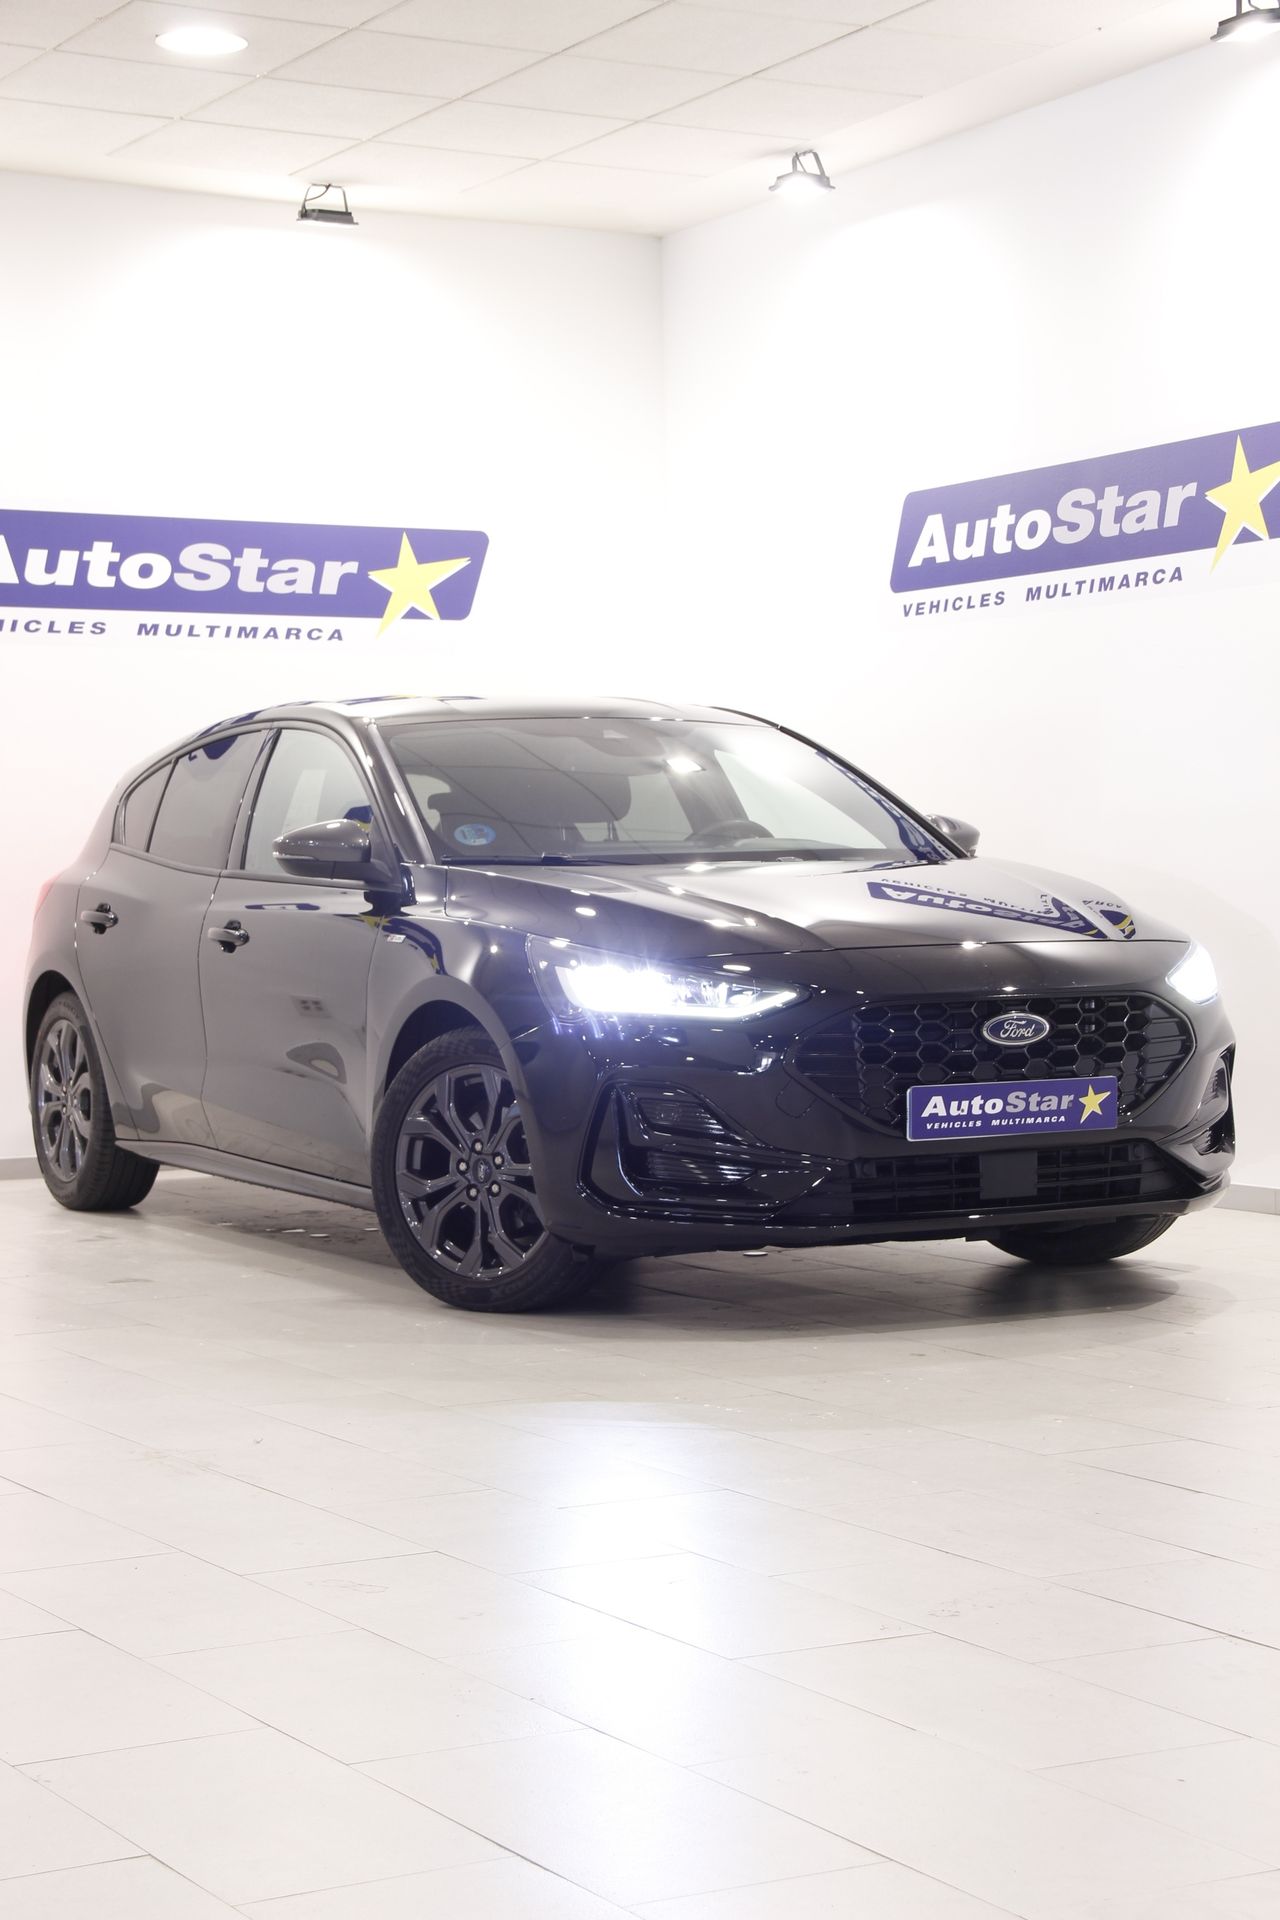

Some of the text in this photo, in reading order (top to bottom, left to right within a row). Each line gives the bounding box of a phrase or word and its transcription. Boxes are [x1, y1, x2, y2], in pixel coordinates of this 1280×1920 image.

[908, 482, 1198, 568] AutoStar
[903, 566, 1184, 617] VEHICLES MULTIMARCA
[0, 619, 344, 641] ICLES MULTIMARCA
[1000, 1020, 1036, 1038] Ford
[921, 1091, 1075, 1118] AutoStar
[926, 1115, 1066, 1130] VEHICLES MULTIMARCA
